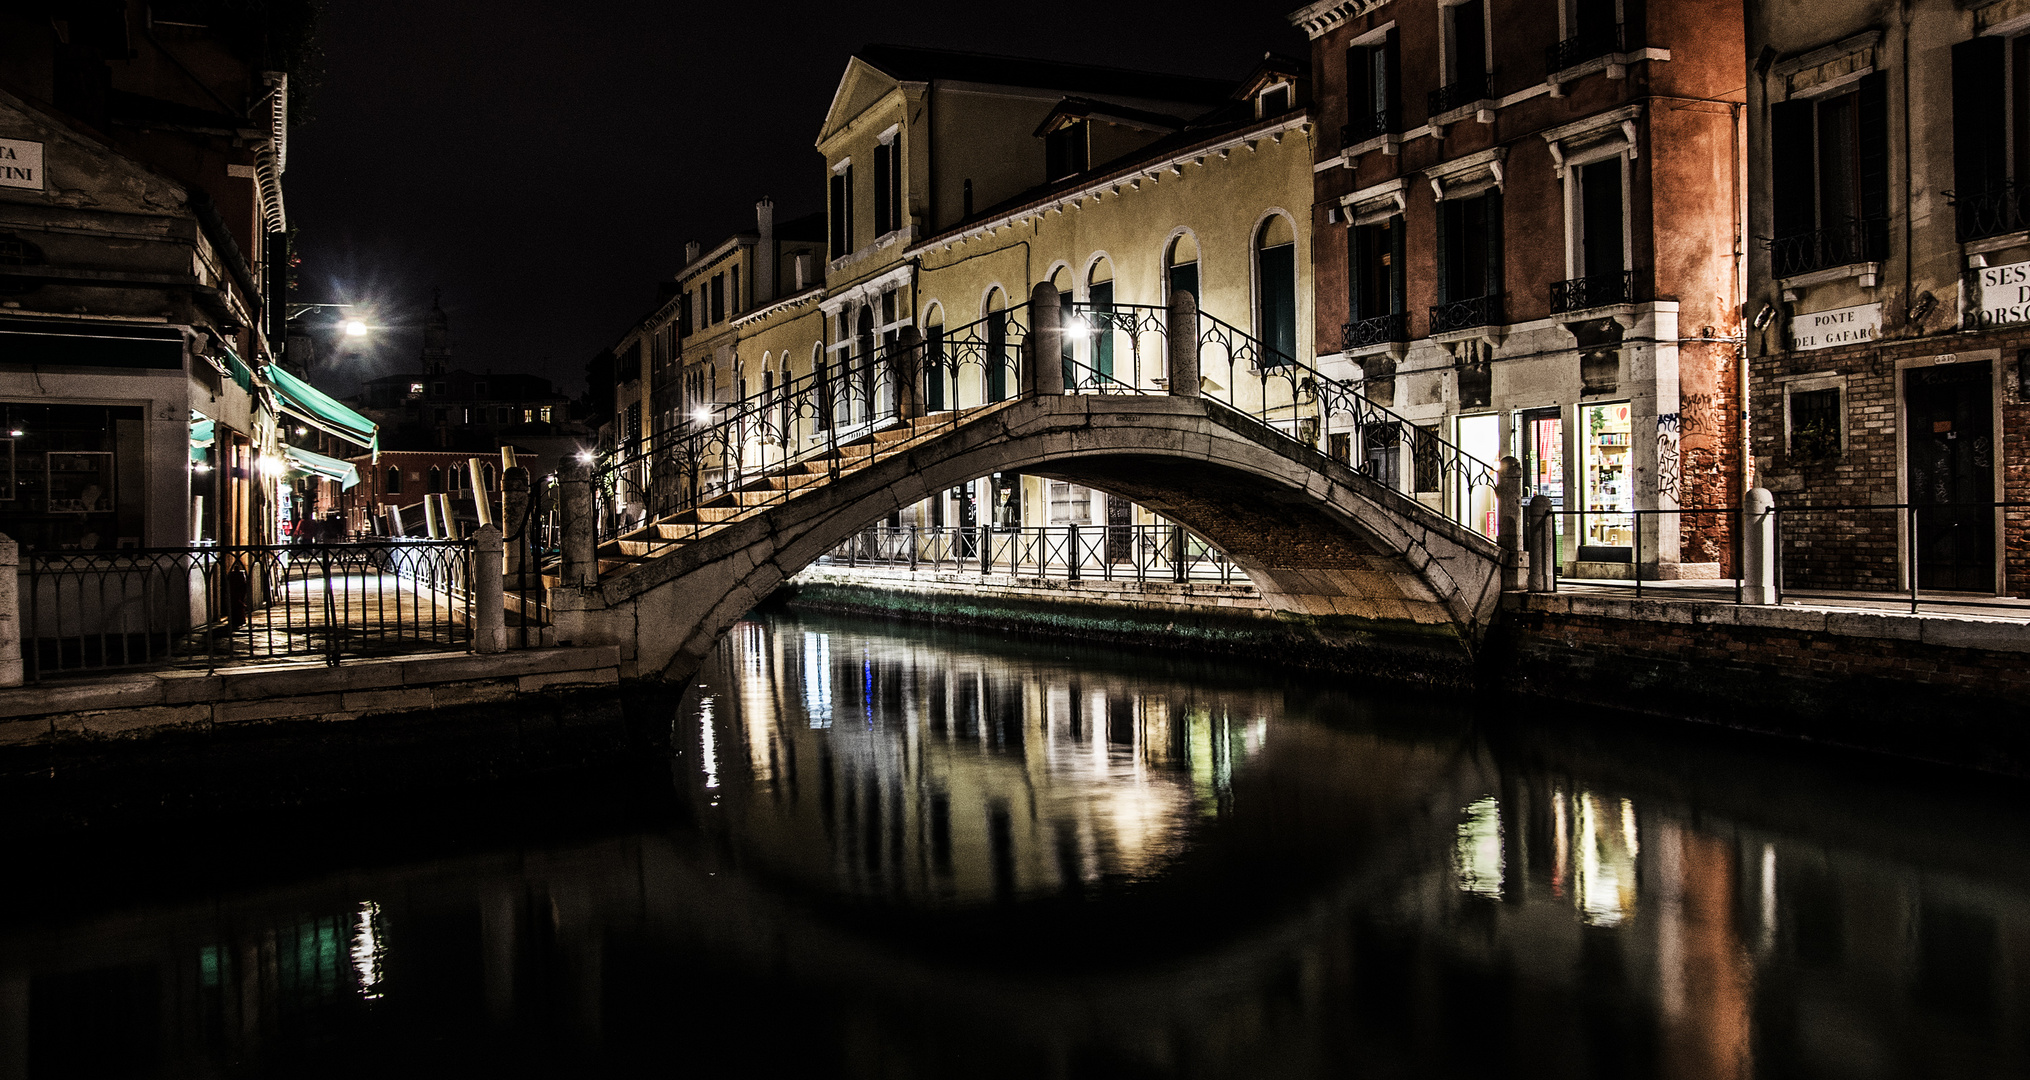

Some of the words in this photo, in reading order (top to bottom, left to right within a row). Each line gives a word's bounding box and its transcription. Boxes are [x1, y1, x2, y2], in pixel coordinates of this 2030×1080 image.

[1985, 264, 2030, 287] SES
[1815, 311, 1855, 327] PONTE
[1794, 335, 1817, 348] DEL
